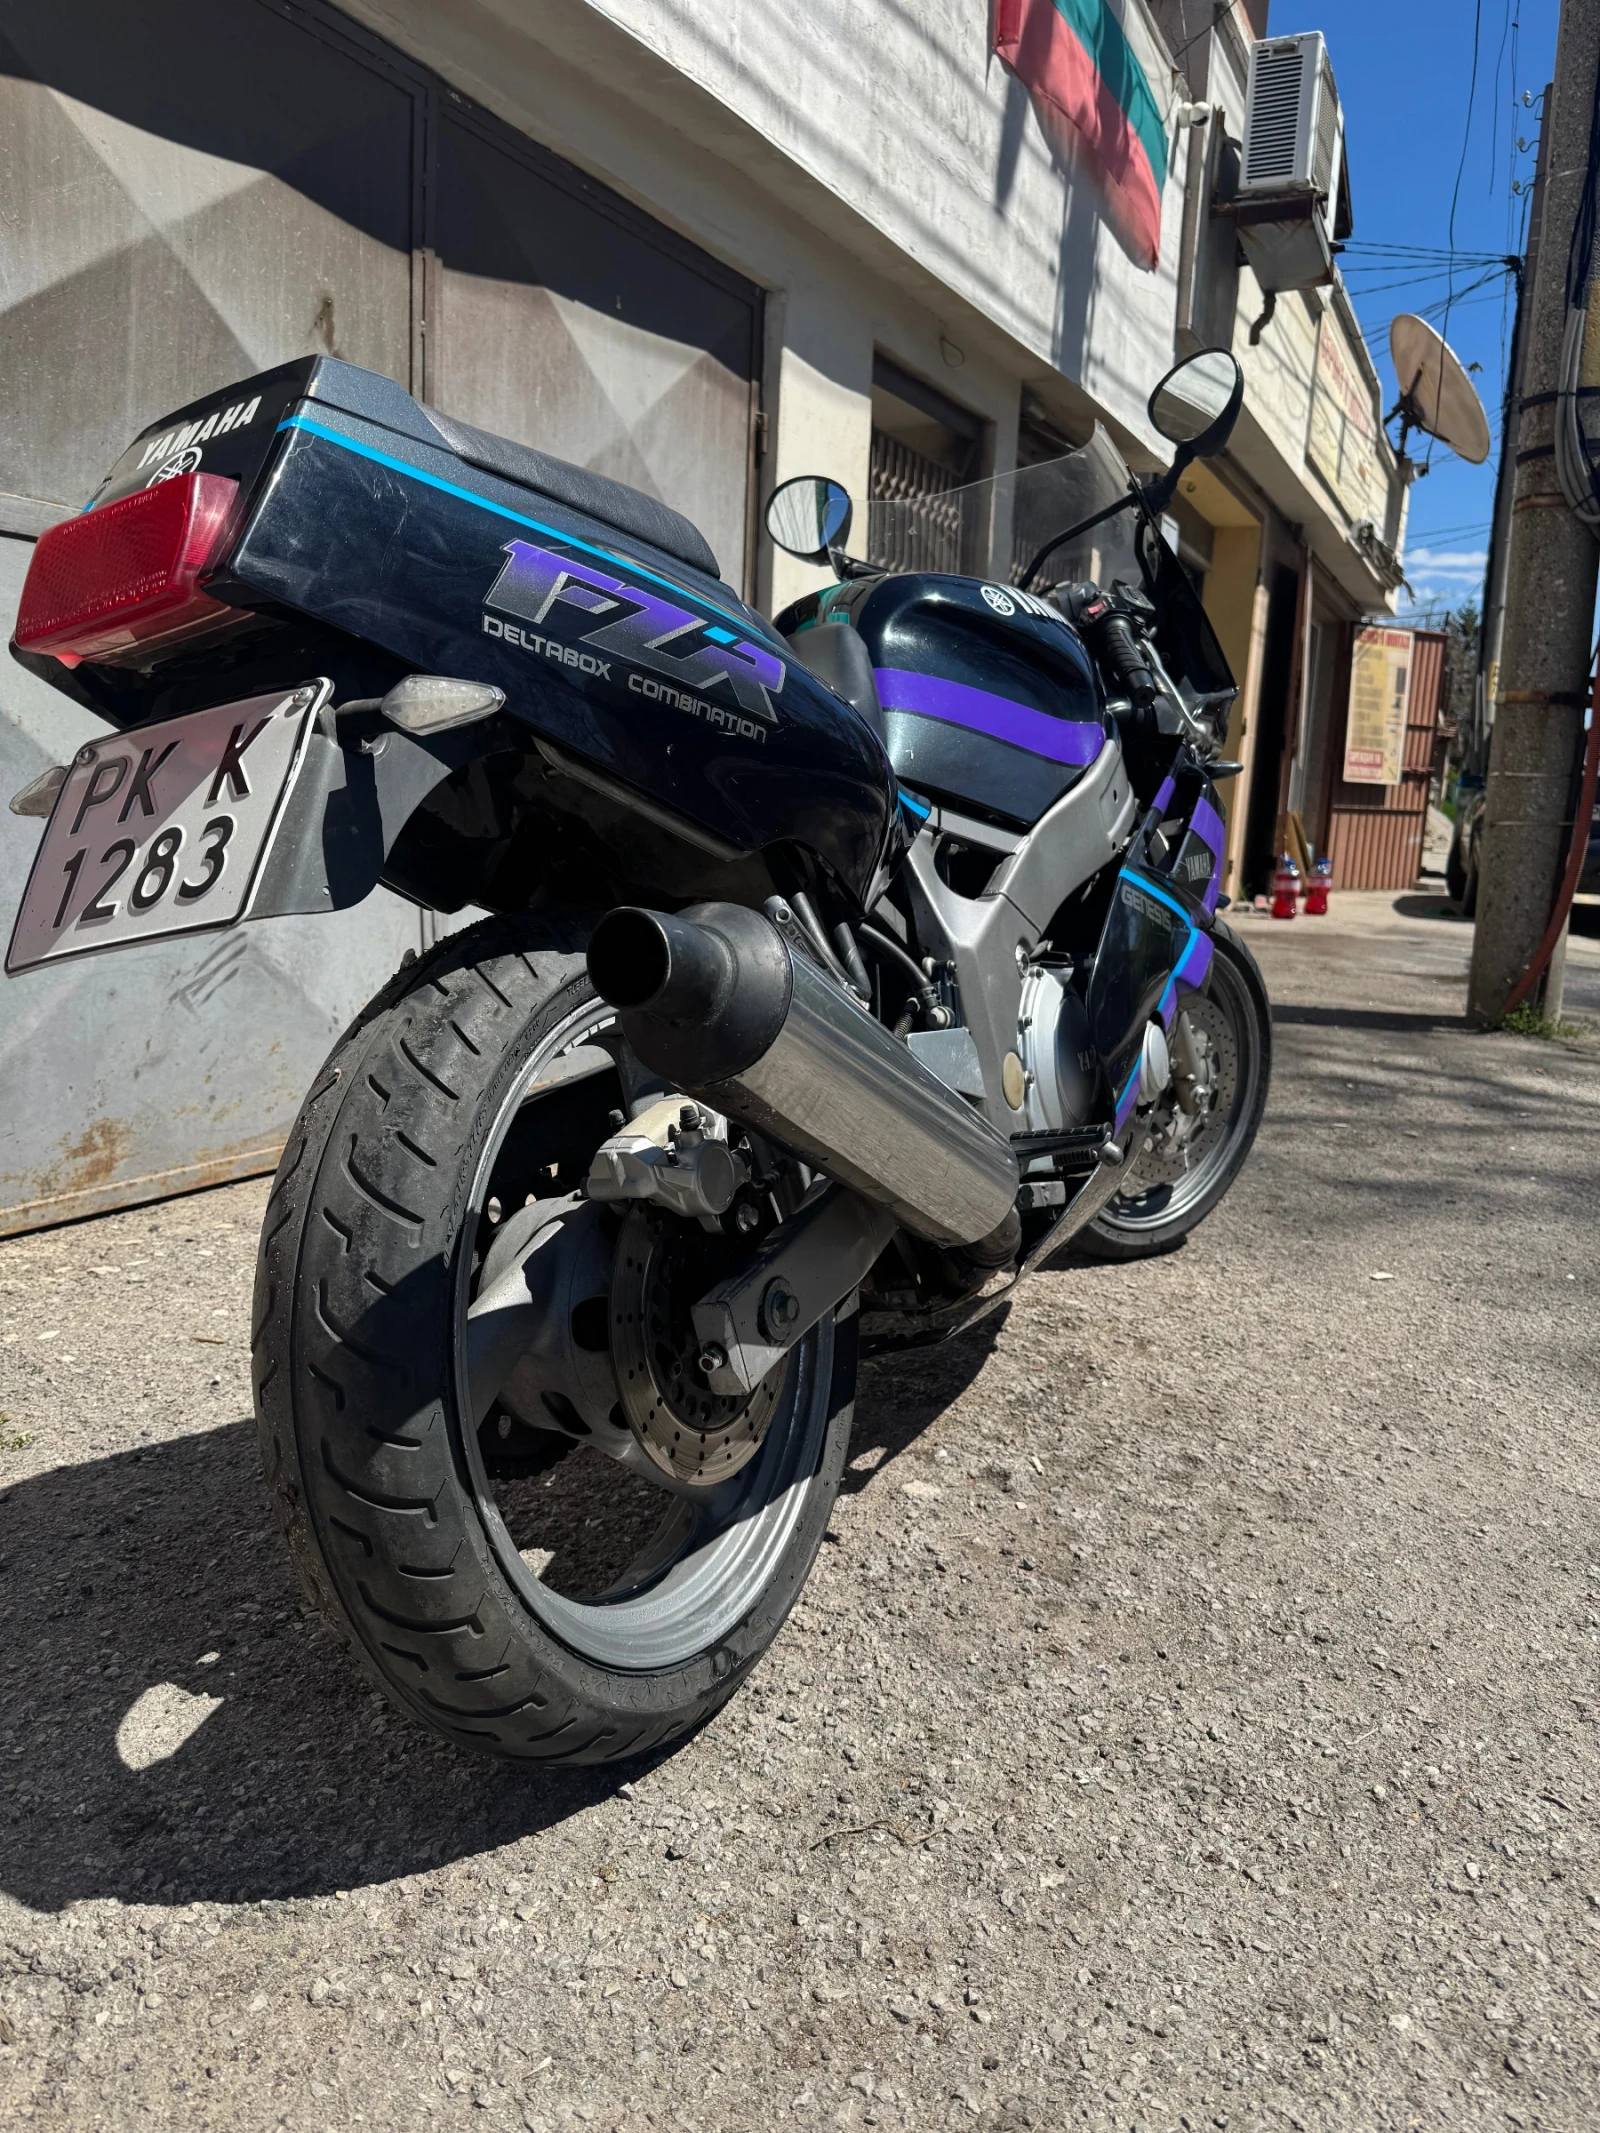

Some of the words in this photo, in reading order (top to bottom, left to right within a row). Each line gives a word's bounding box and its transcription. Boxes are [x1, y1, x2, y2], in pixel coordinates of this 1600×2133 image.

[136, 395, 262, 470] YAMAHA
[483, 614, 612, 682] DELTABOX
[628, 673, 767, 743] COMBINATION
[69, 739, 183, 837] PK
[206, 715, 275, 803] K
[52, 814, 236, 930] 1283
[1120, 885, 1172, 933] GENESIS
